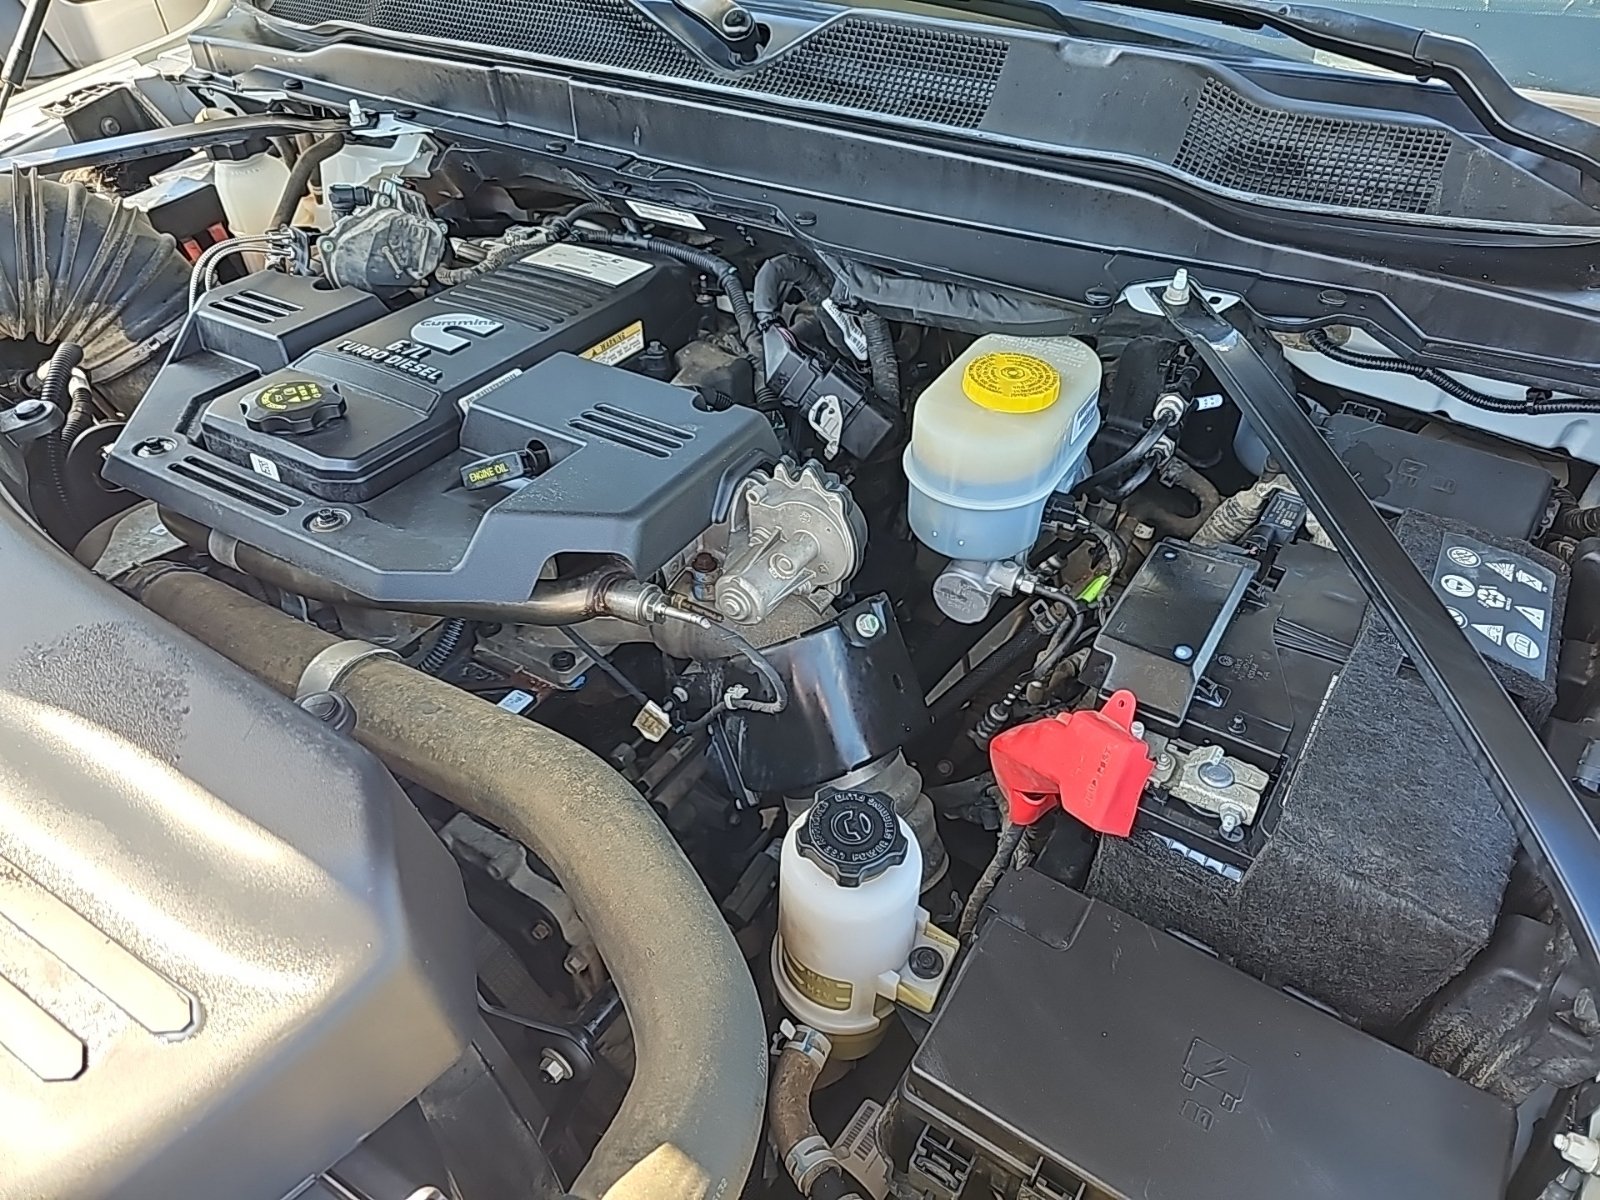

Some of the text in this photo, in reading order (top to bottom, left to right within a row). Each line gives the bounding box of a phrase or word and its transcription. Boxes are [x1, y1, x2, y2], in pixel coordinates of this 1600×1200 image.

[335, 339, 443, 384] TURBO DIESEL
[385, 339, 431, 361] 6.7L
[468, 463, 509, 483] ENGINE OIL
[834, 792, 895, 862] POWER STEERING FLUID
